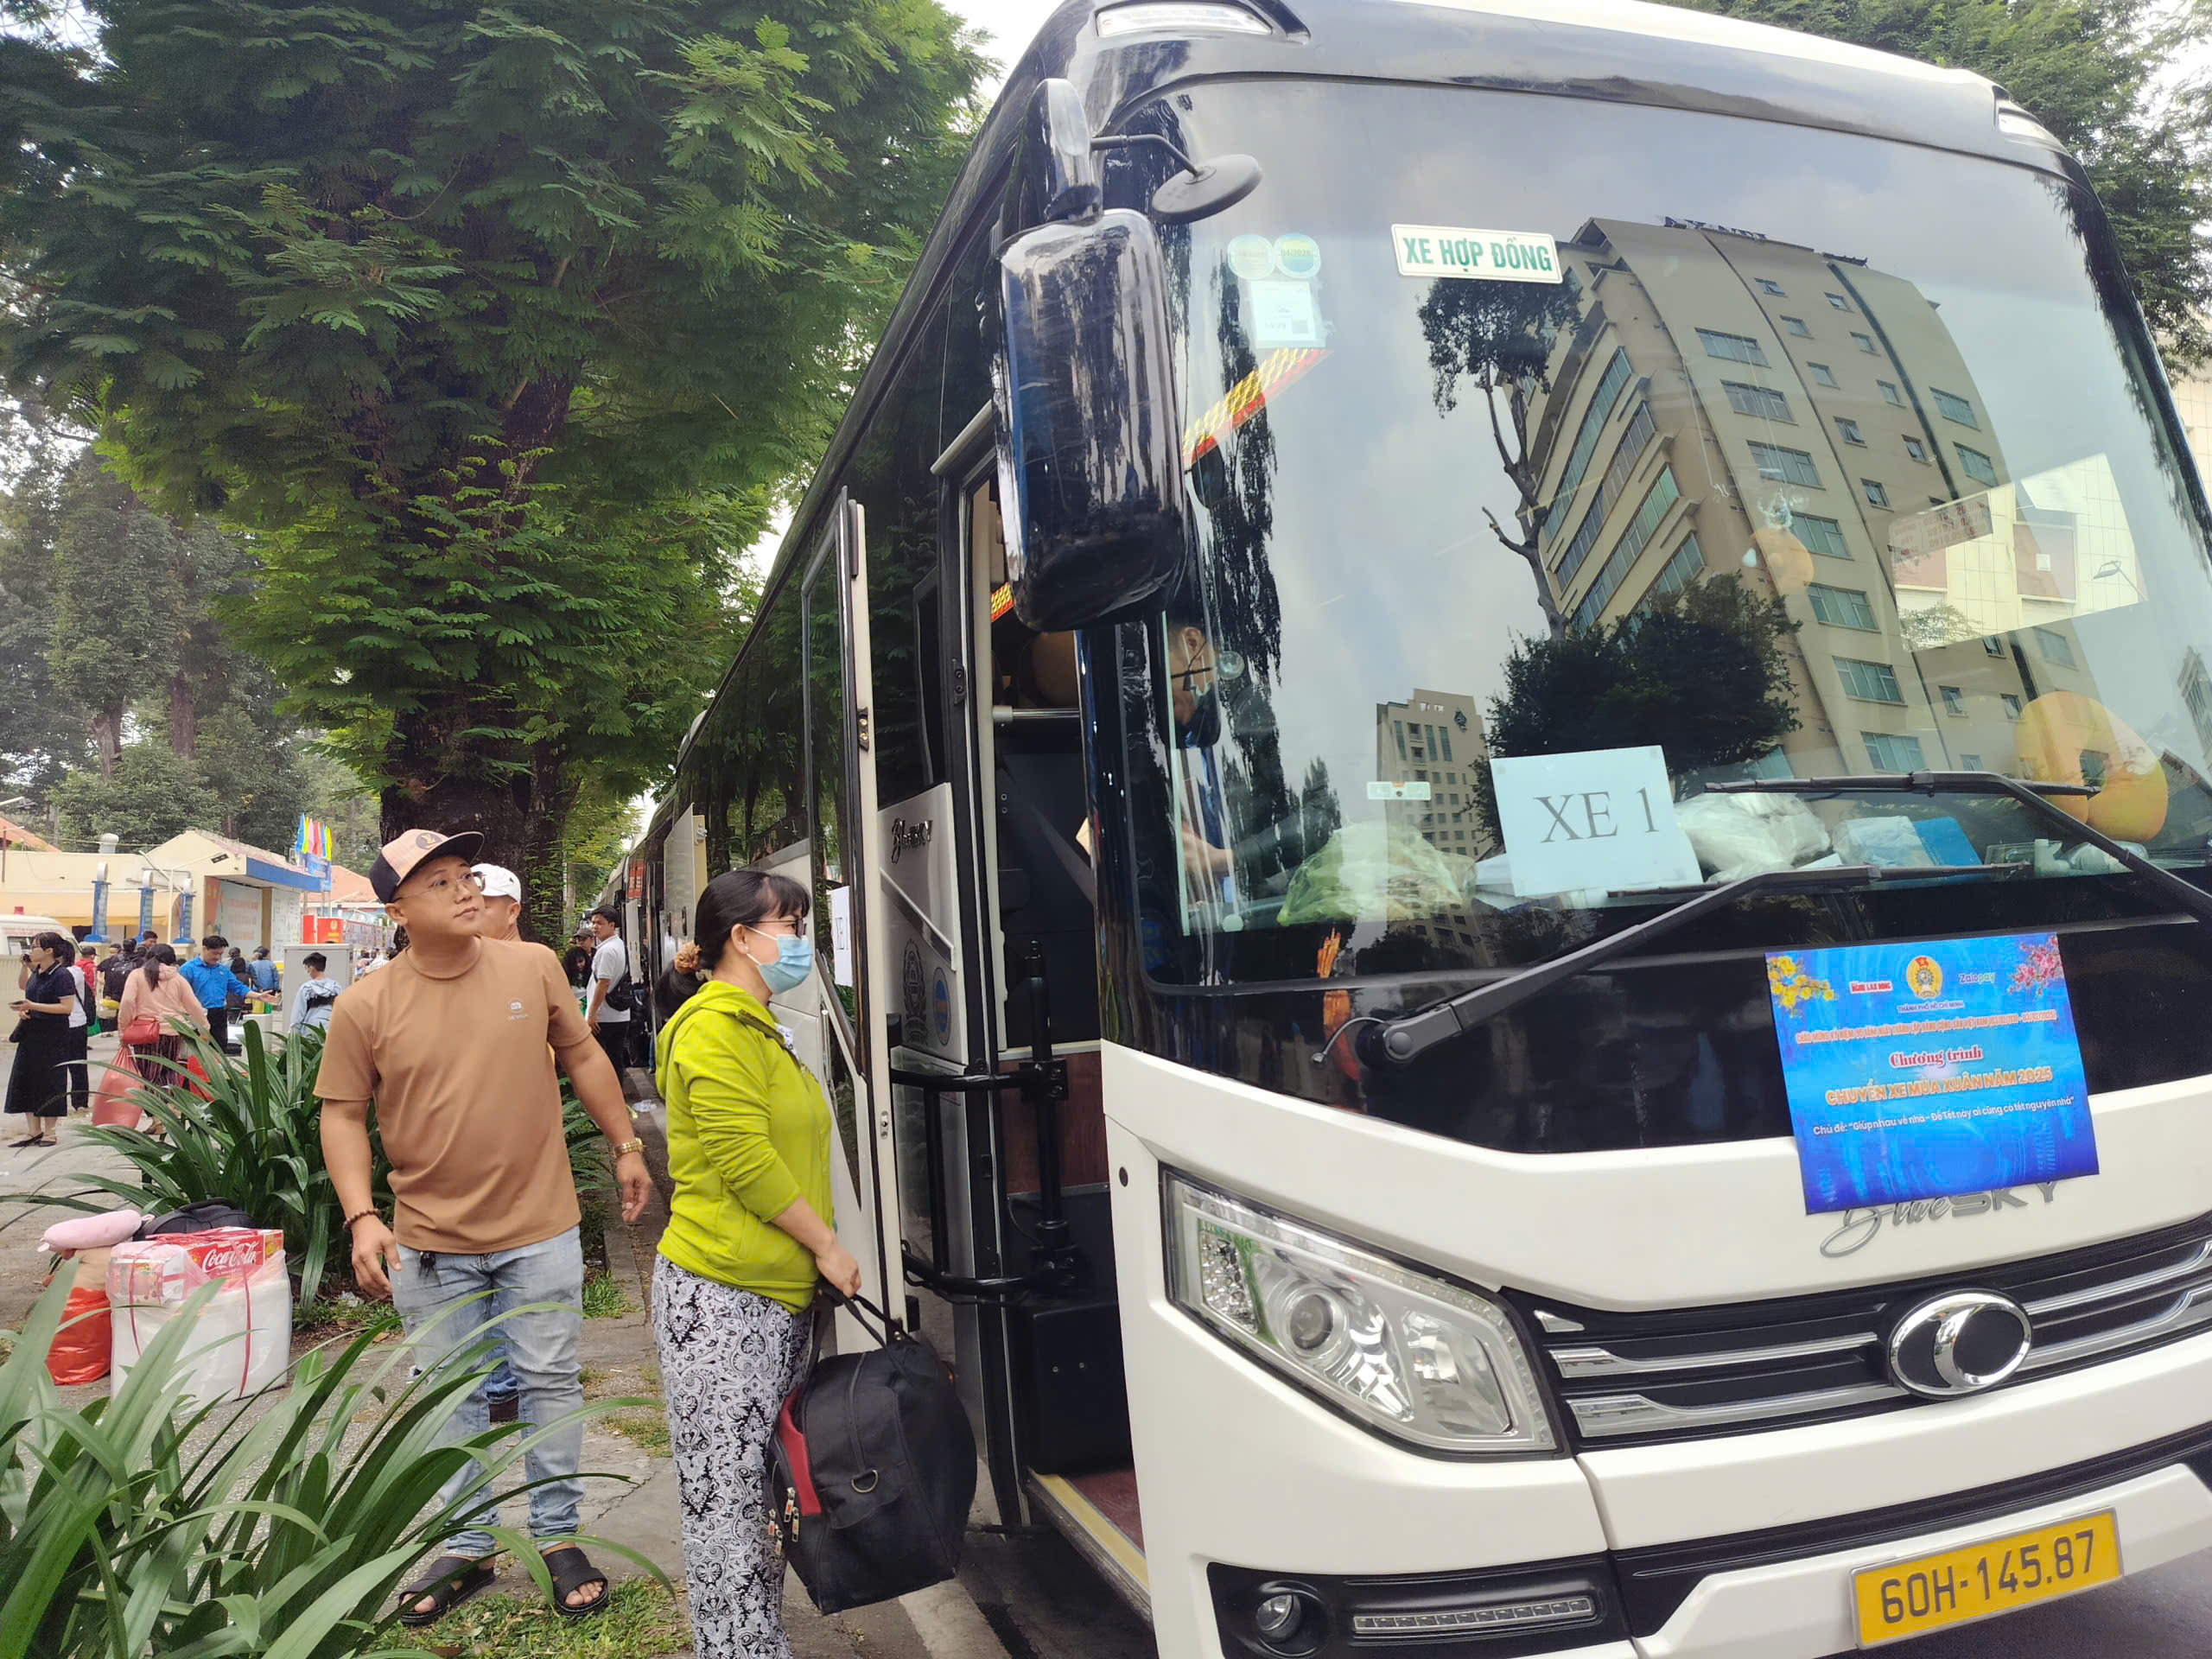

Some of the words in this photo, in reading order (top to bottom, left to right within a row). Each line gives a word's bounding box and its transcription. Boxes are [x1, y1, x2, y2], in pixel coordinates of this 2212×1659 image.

[1402, 237, 1434, 264] XE
[1438, 238, 1484, 272] HỢP
[1490, 236, 1553, 271] ĐỒNG
[1532, 790, 1618, 845] XE
[1635, 785, 1660, 834] 1
[1930, 1001, 1938, 1009] HỒ
[1890, 1050, 1944, 1068] Chương
[1947, 1045, 1983, 1062] trình
[1825, 1078, 1888, 1105] CHUYẾN
[1887, 1082, 1907, 1100] XE
[1907, 1077, 1942, 1097] MÙA
[1942, 1071, 1983, 1093] XUÂN
[1983, 1068, 2018, 1088] NĂM
[2018, 1065, 2053, 1084] 2025
[1973, 1106, 1981, 1116] ai
[1982, 1106, 2004, 1116] cũng
[1880, 1529, 2094, 1624] 60H-145.87
